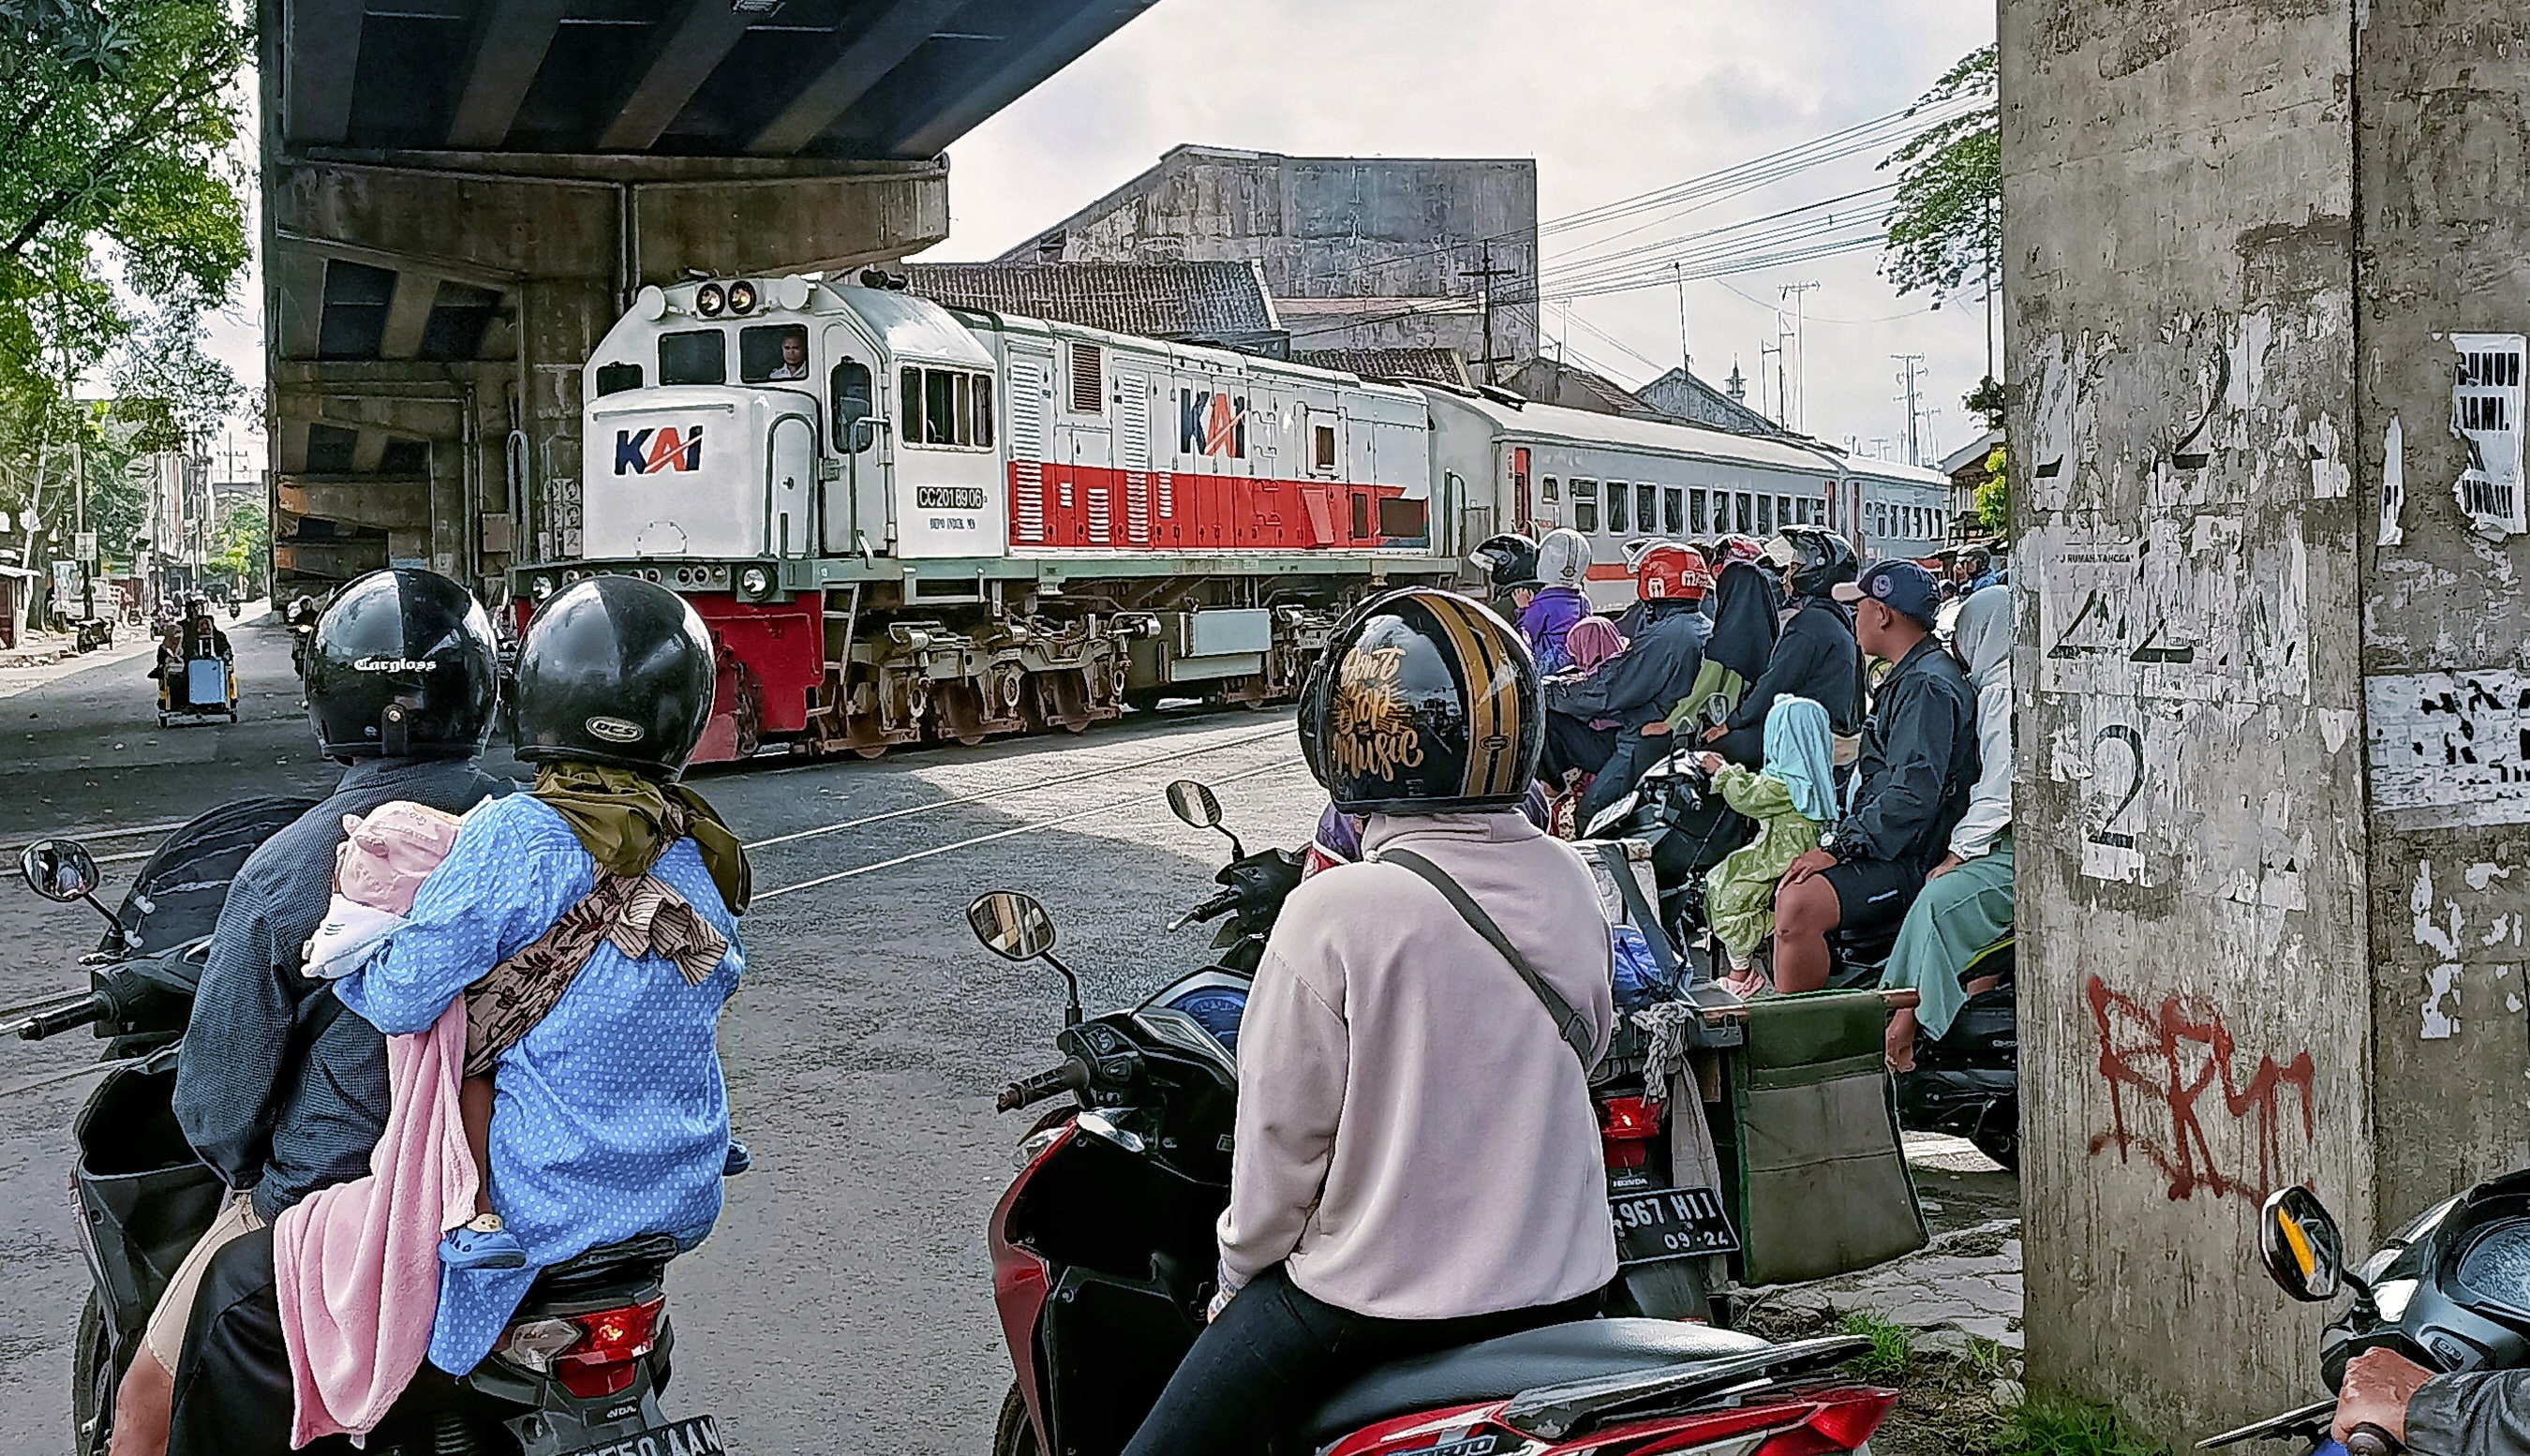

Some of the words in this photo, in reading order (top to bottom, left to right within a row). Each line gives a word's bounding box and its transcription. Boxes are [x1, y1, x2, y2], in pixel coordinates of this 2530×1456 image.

[1180, 387, 1246, 459] KAI
[614, 424, 704, 476] KAI
[353, 657, 437, 673] Cargloss
